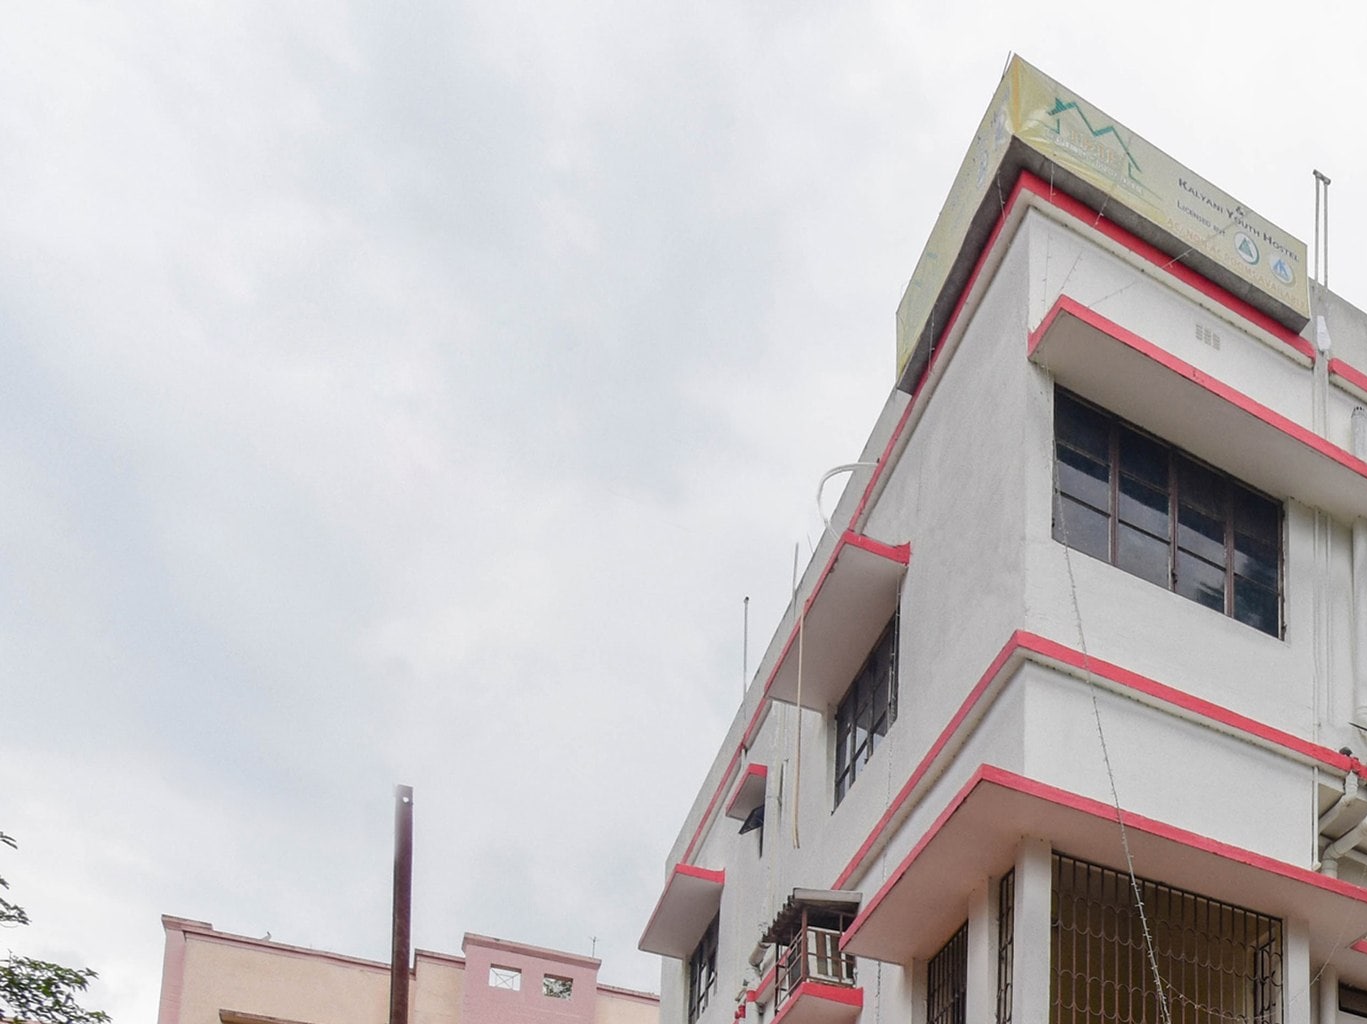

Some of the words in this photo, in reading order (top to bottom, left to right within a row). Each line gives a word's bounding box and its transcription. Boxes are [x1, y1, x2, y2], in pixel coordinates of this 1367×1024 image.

[1178, 178, 1223, 213] KALYANI
[1226, 207, 1261, 238] YOUTH
[1263, 232, 1300, 263] HOSTEL
